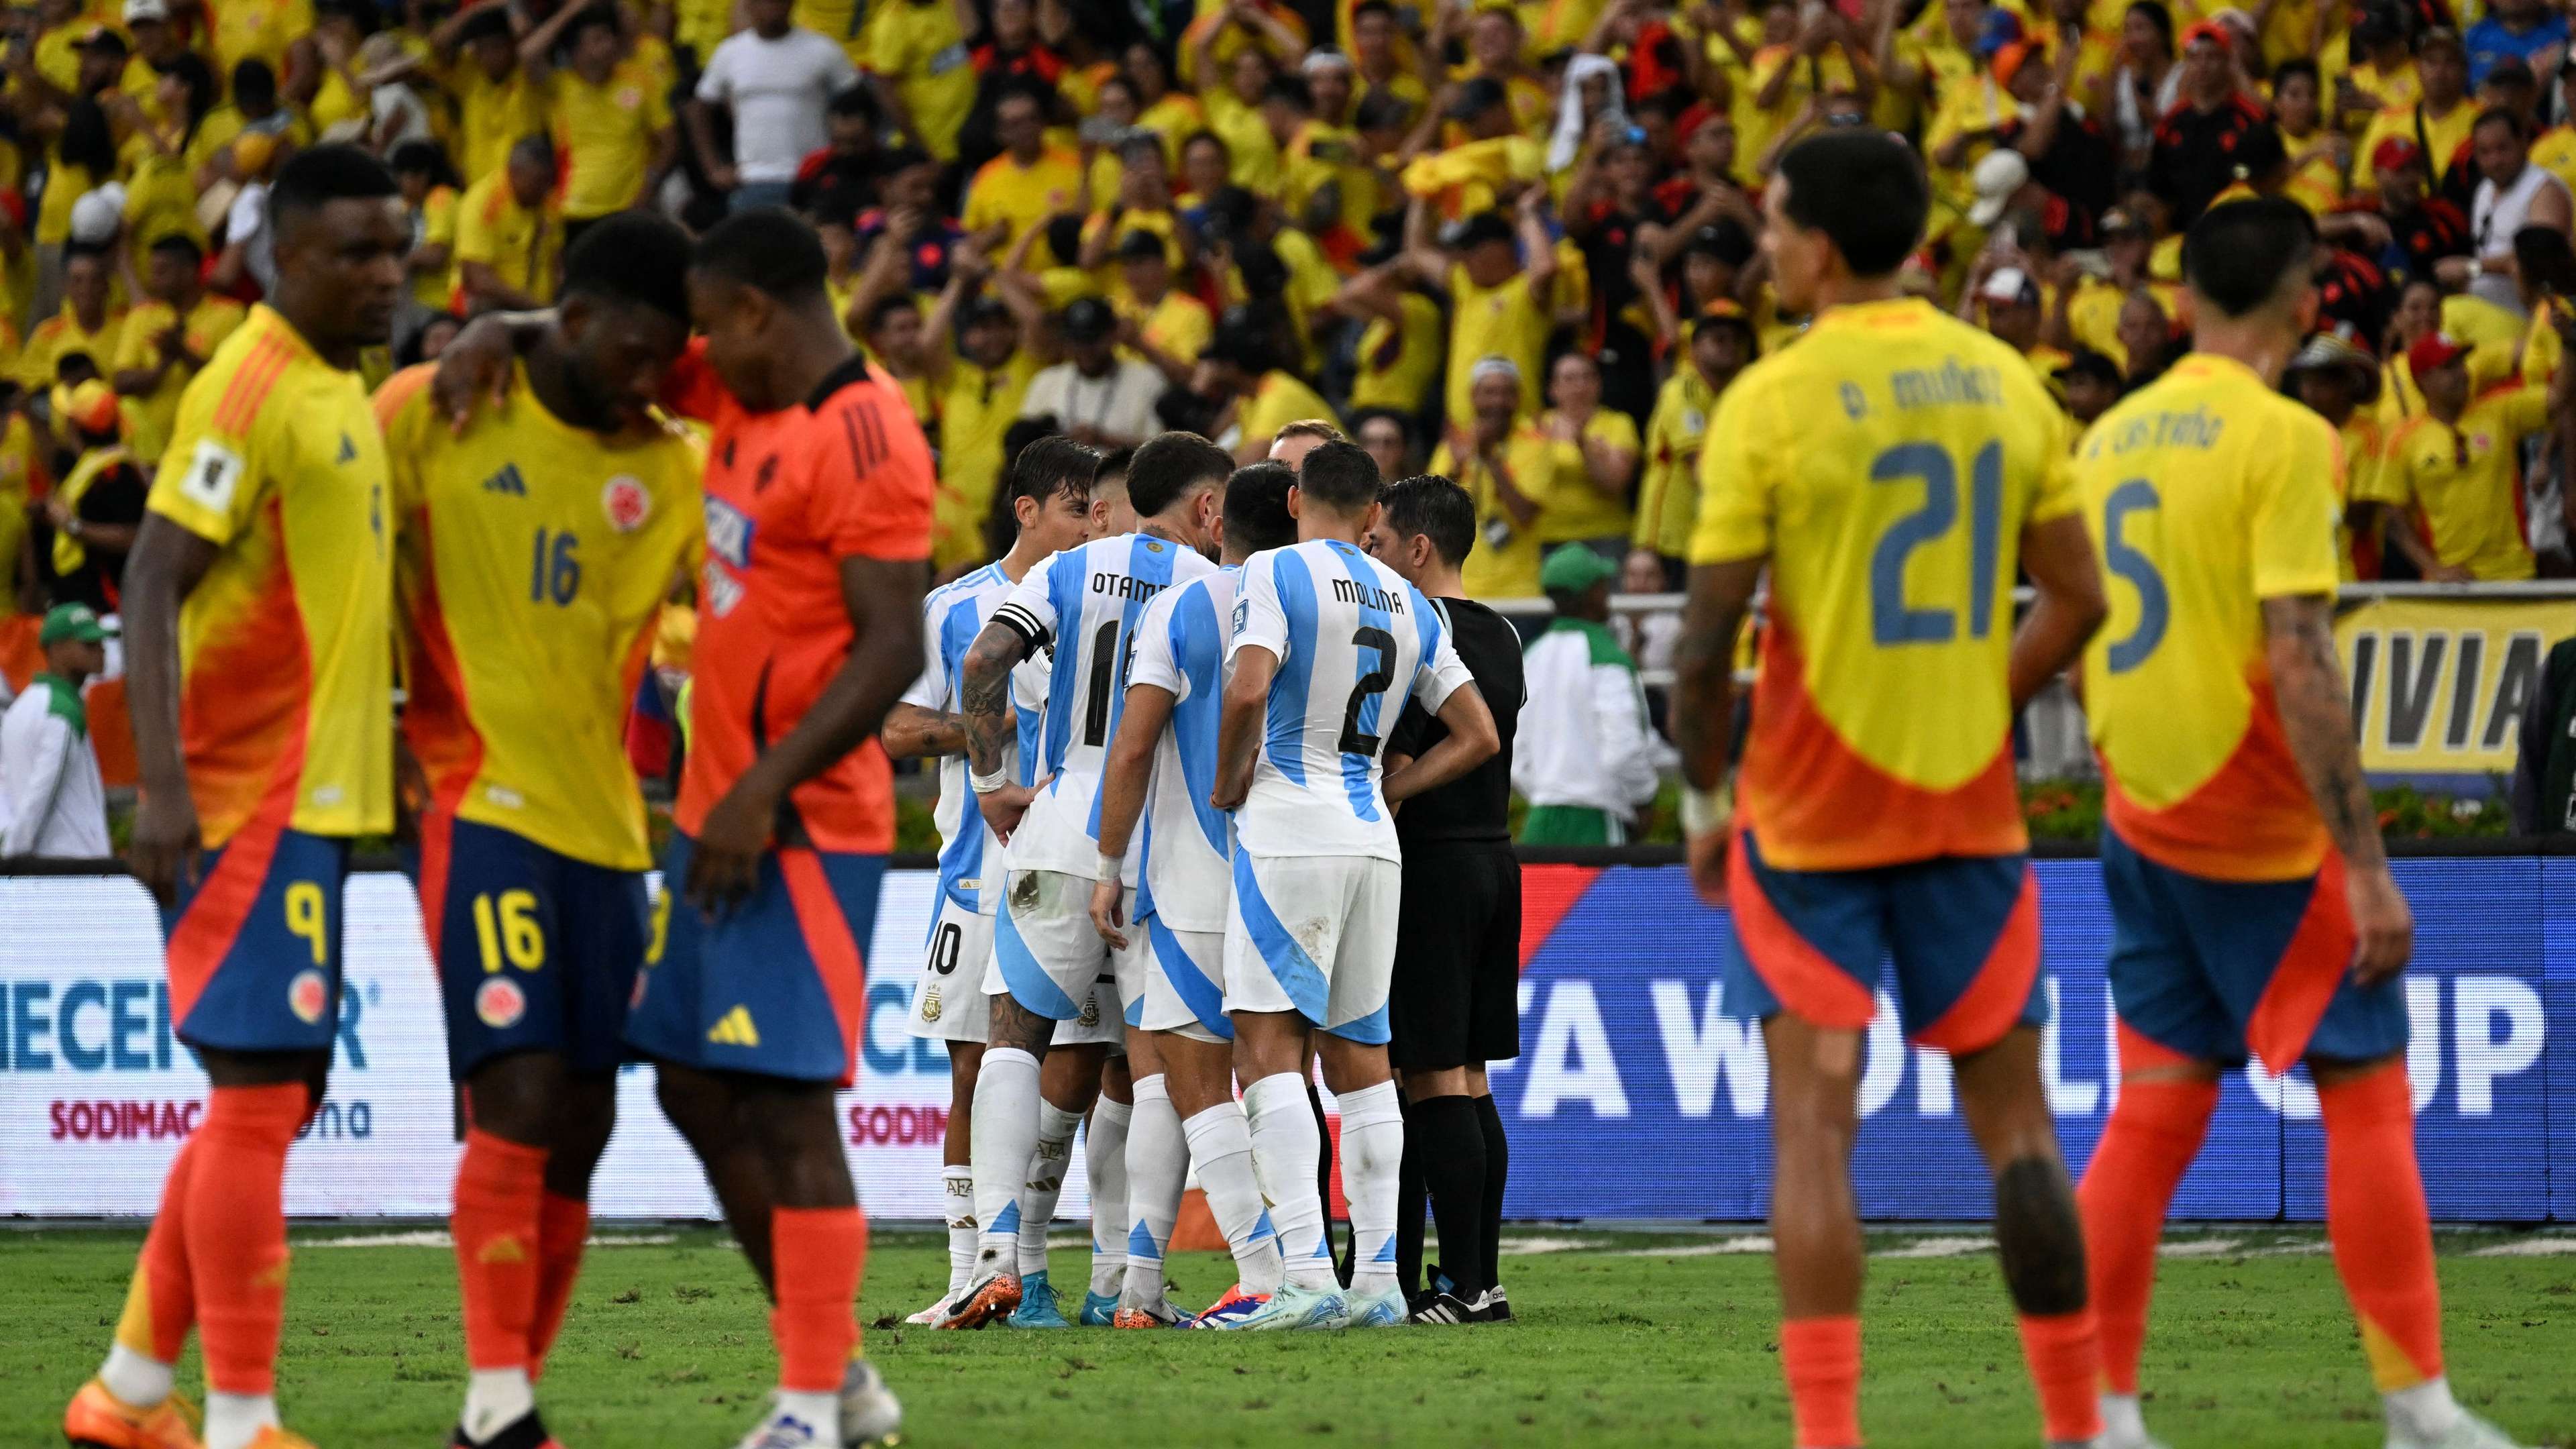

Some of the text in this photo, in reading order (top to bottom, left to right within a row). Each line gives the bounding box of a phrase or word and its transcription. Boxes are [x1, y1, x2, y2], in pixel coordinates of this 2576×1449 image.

[531, 527, 581, 608] 16
[1870, 438, 2004, 646] 21
[2104, 479, 2169, 674] 5
[1332, 578, 1405, 615] MOLINA
[1338, 626, 1397, 758] 2
[284, 882, 327, 965] 9
[473, 888, 545, 973] 16
[927, 920, 962, 975] 10
[50, 1100, 201, 1140] SODIMAC
